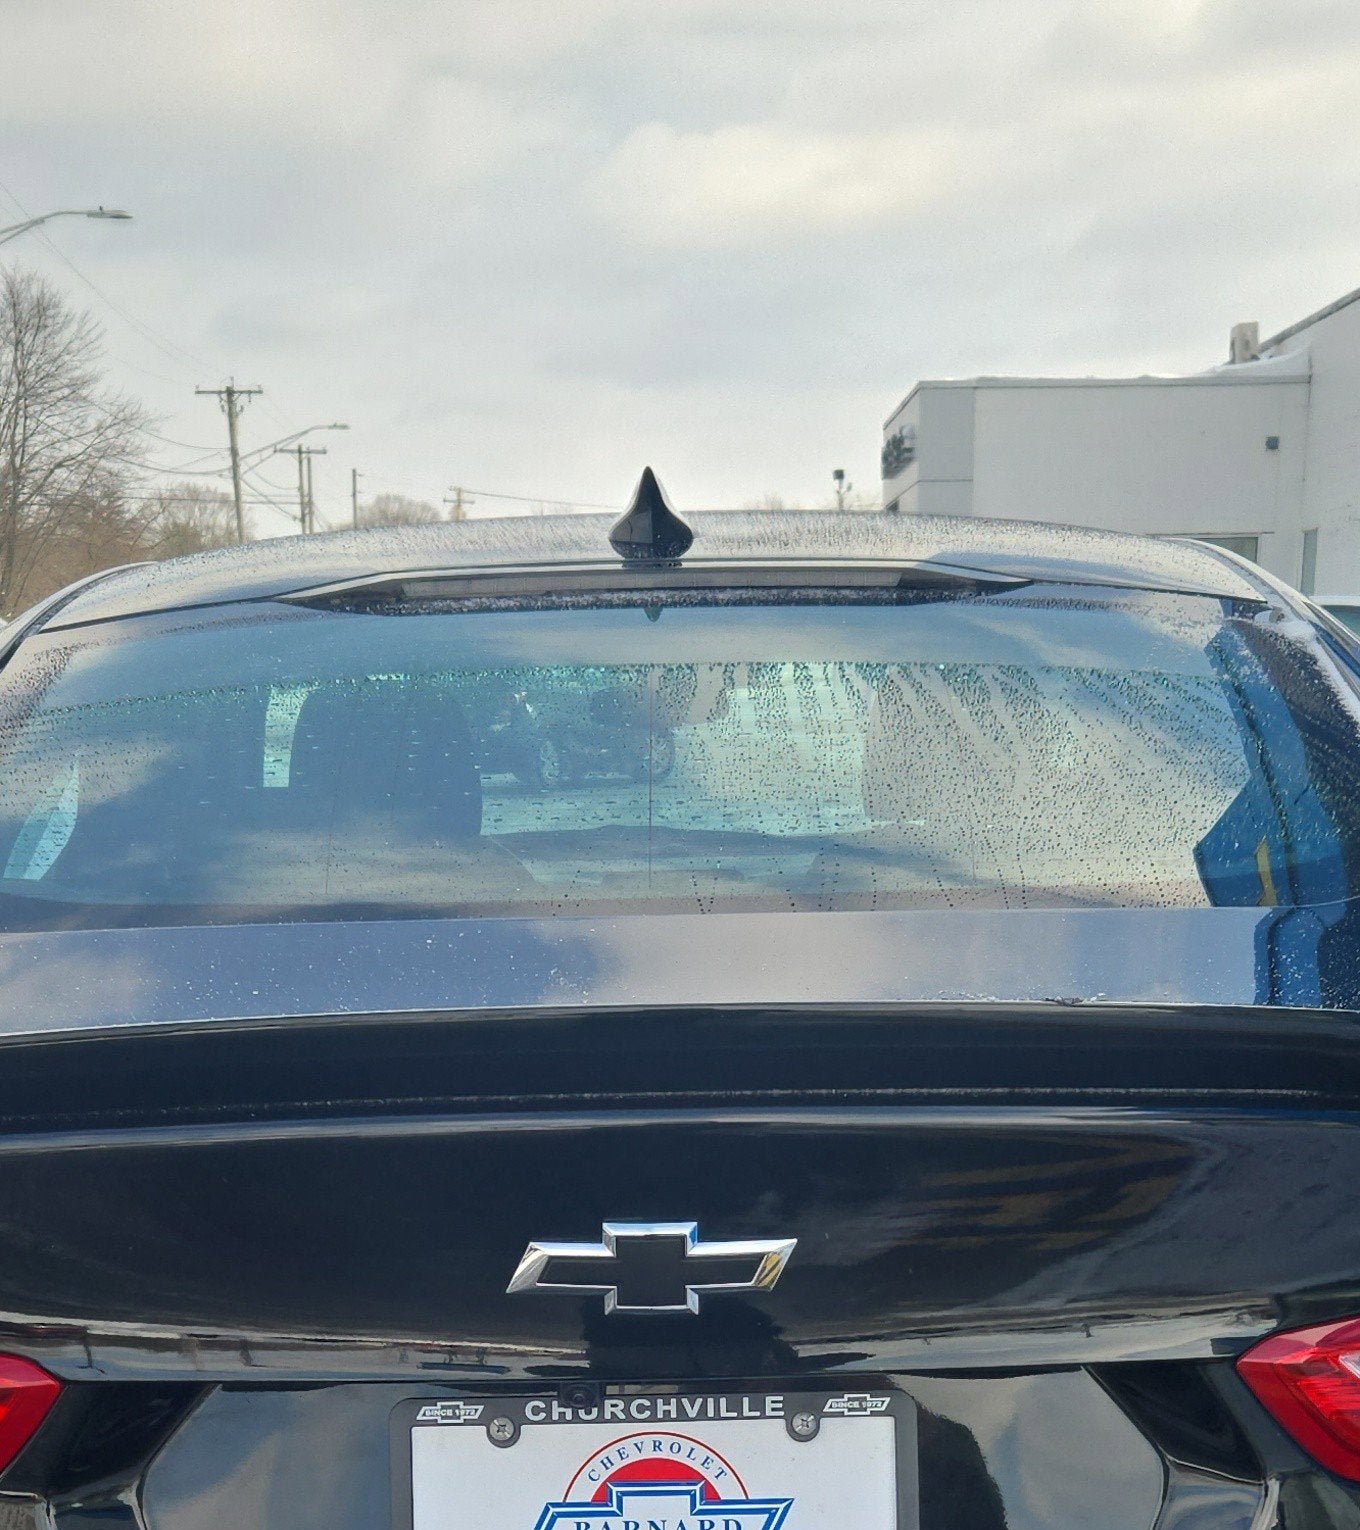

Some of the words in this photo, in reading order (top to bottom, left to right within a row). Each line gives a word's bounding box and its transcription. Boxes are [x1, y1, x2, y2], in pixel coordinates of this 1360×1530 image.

[425, 1409, 452, 1417] SINCE
[525, 1396, 784, 1421] CHURCHVILLE
[831, 1401, 859, 1409] SINCE
[588, 1439, 728, 1482] CHEVROLET
